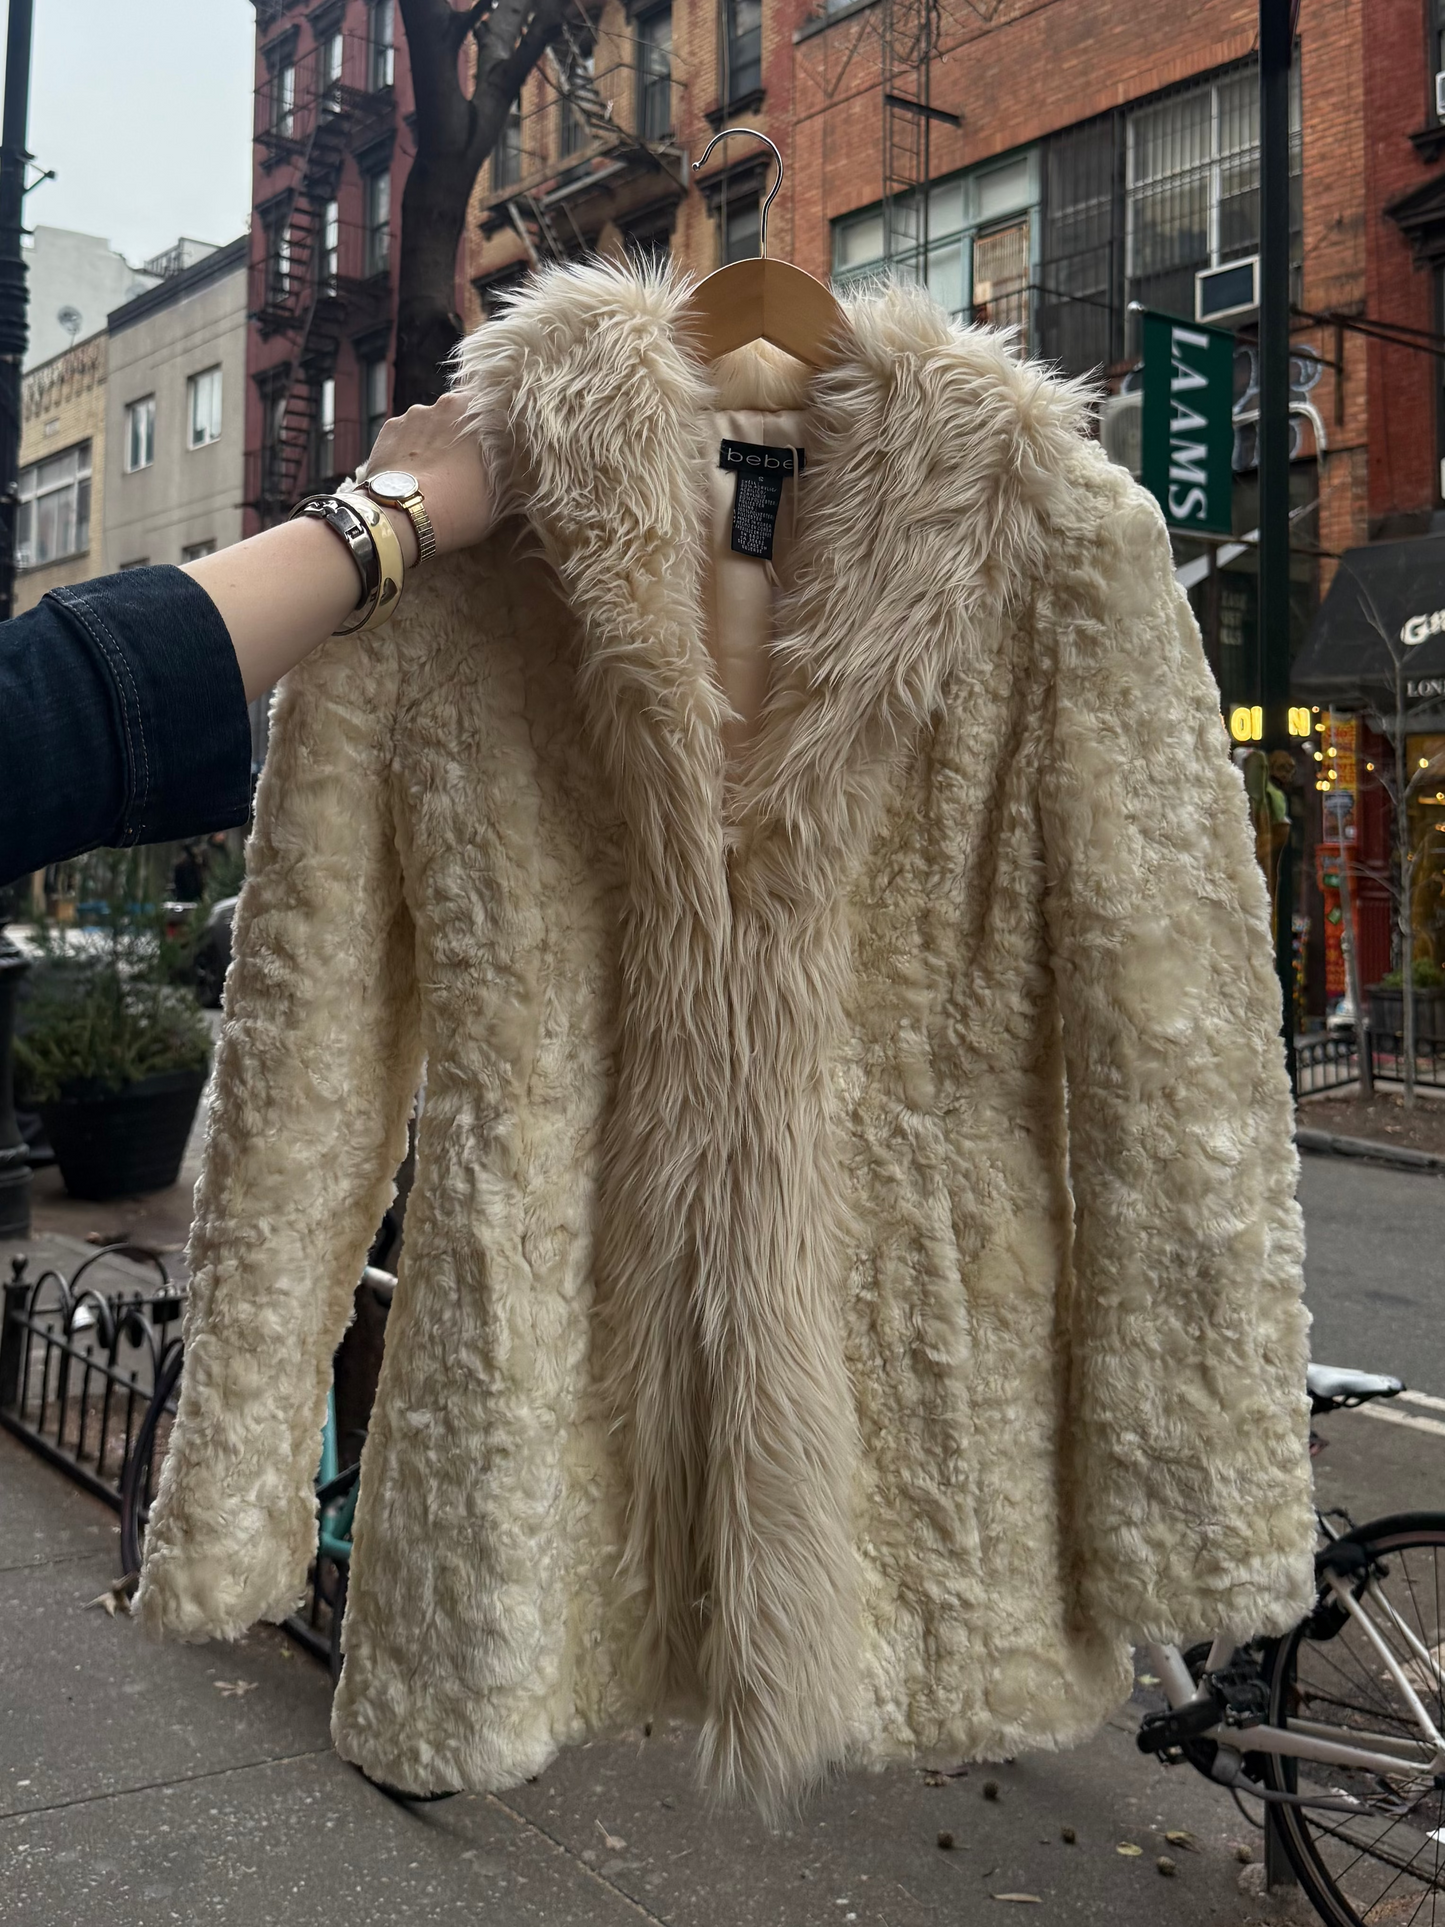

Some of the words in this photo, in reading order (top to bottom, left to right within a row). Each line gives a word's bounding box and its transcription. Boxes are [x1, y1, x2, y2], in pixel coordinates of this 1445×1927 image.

[1168, 326, 1210, 521] LAAMS
[727, 448, 793, 469] bebe
[1407, 678, 1445, 697] LON
